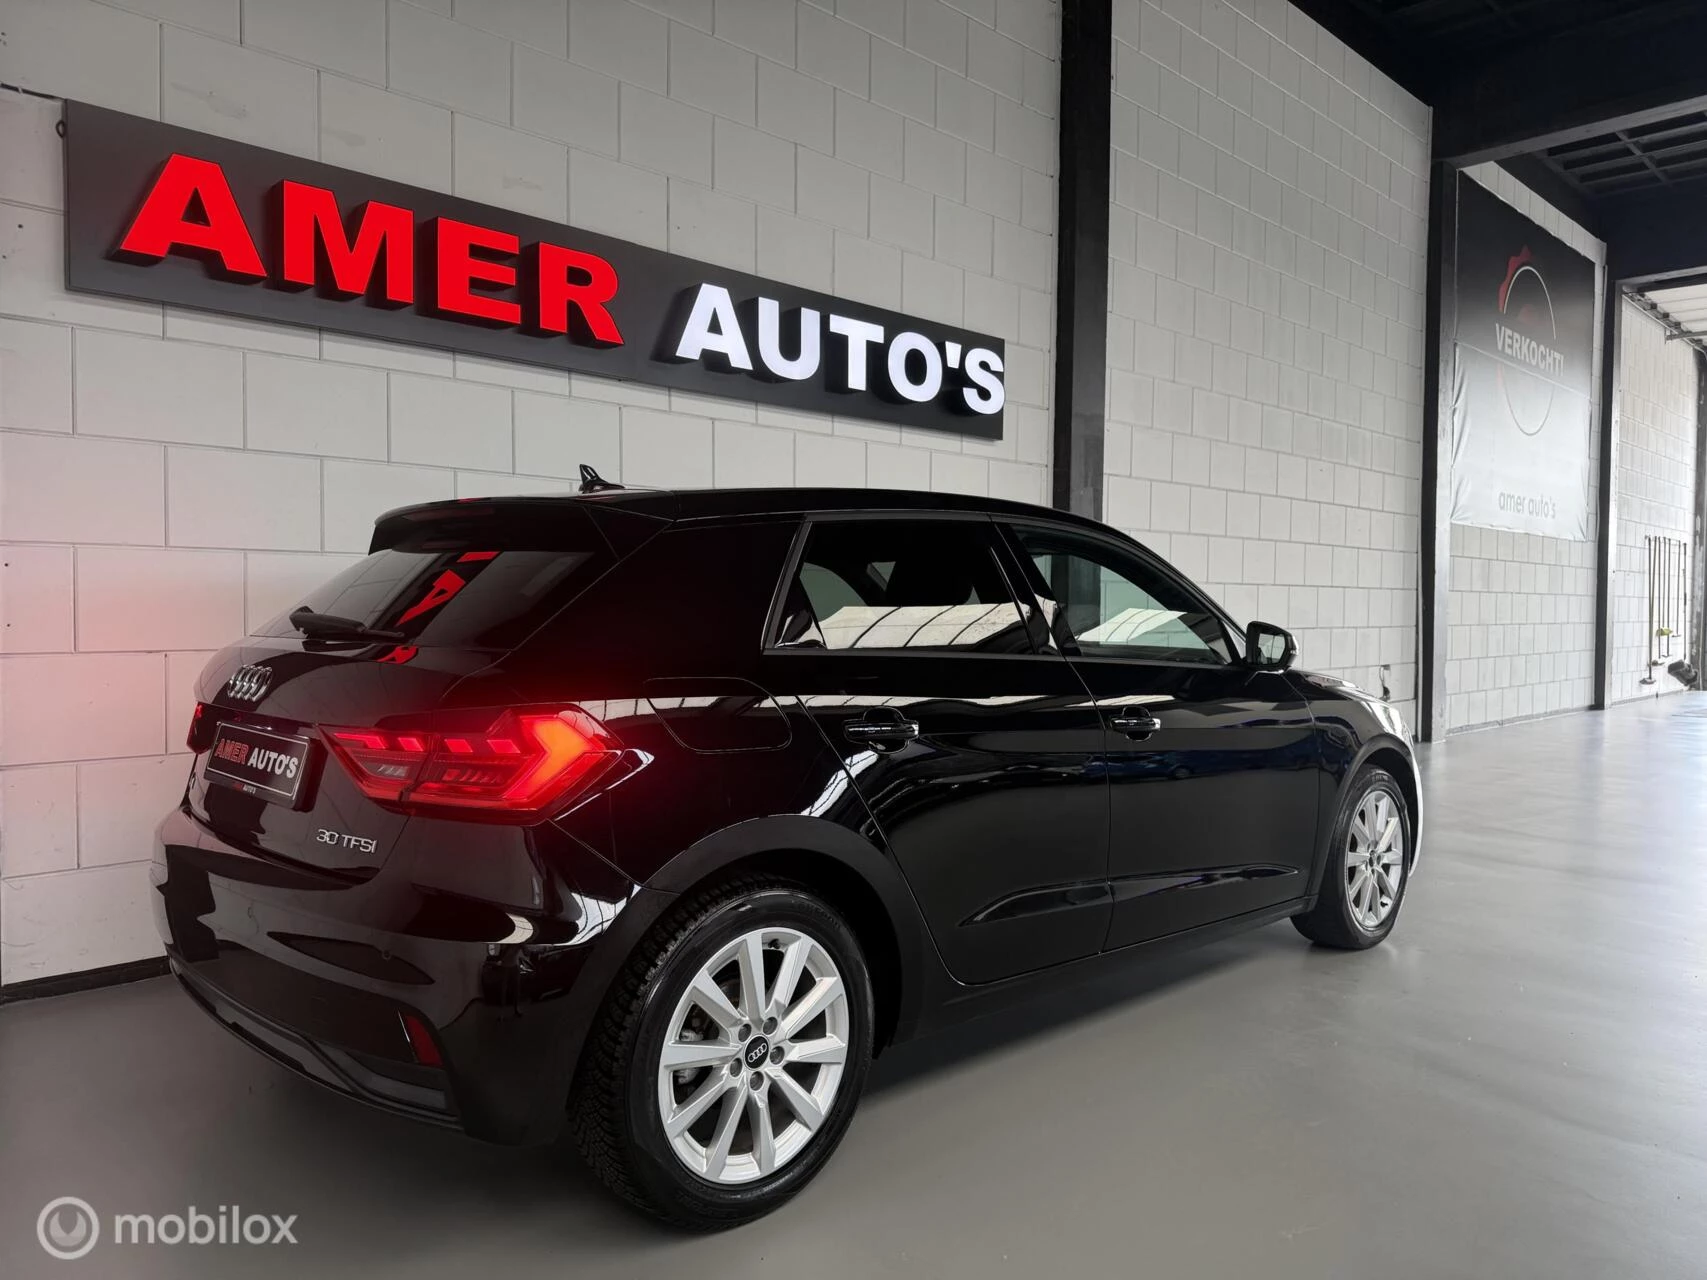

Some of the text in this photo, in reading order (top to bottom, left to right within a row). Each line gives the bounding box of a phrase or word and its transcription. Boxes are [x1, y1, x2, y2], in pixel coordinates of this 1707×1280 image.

[119, 153, 1006, 415] AMER AUTO'S
[1498, 491, 1557, 519] amer auto's
[215, 738, 299, 778] AMER AUTO'S
[316, 828, 378, 854] 30 TFSI
